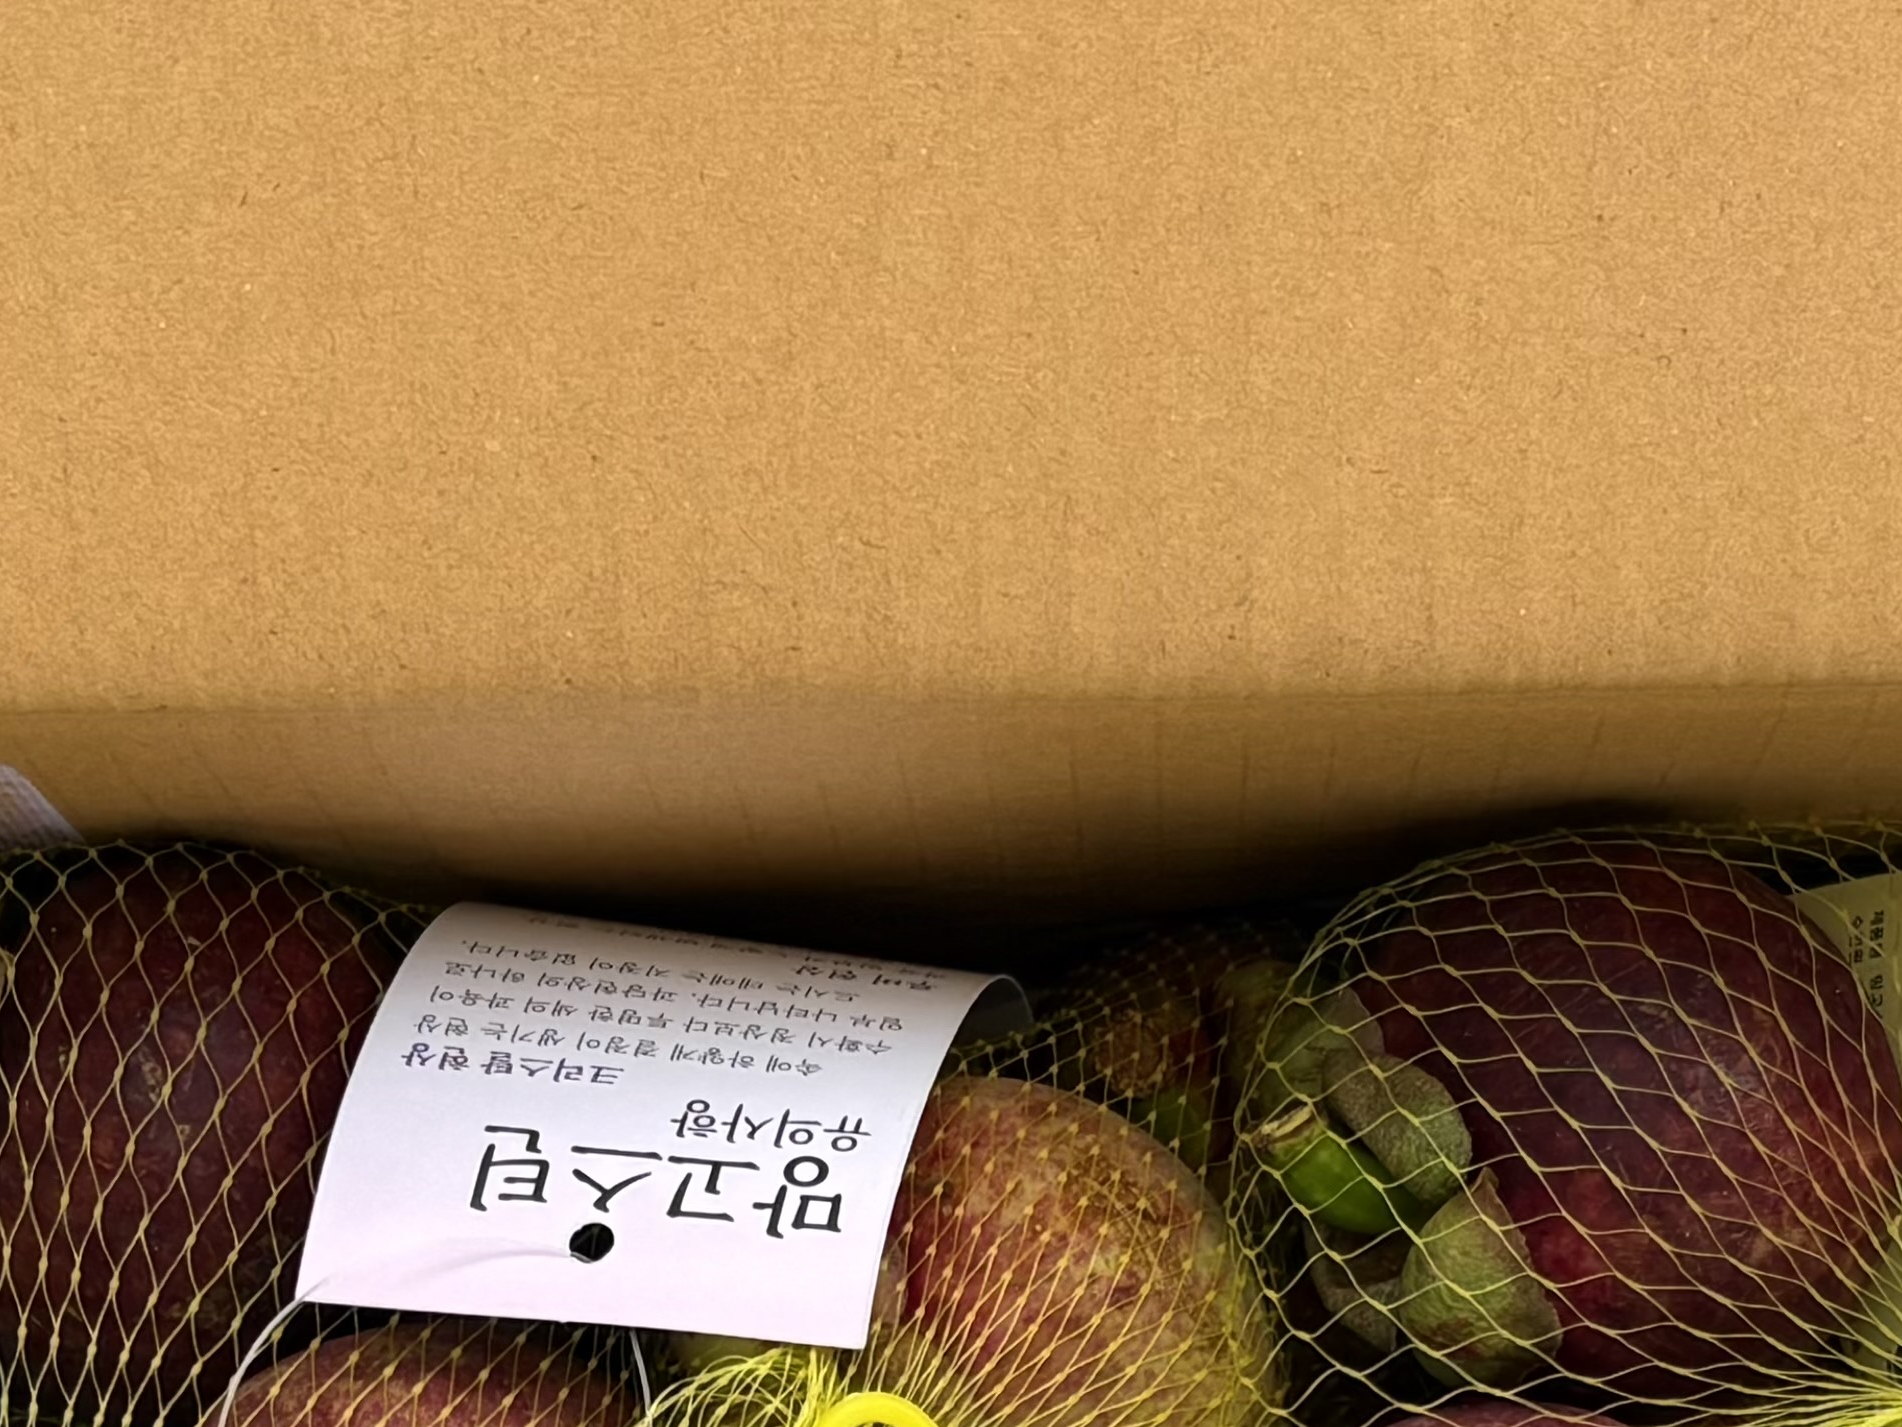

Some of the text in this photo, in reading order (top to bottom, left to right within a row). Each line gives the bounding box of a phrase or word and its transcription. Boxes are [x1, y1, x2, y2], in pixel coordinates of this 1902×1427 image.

[428, 983, 514, 1009] 과육이
[522, 995, 578, 1017] 색의
[587, 1004, 673, 1029] 투명한
[683, 1015, 793, 1044] 정상보다
[416, 1012, 821, 1076] 속에 하얗게 결정이 생기는 현상
[399, 1041, 624, 1085] 크리스탈 현상
[669, 1098, 871, 1152] 유의사항
[468, 1123, 842, 1239] 망고스틴
